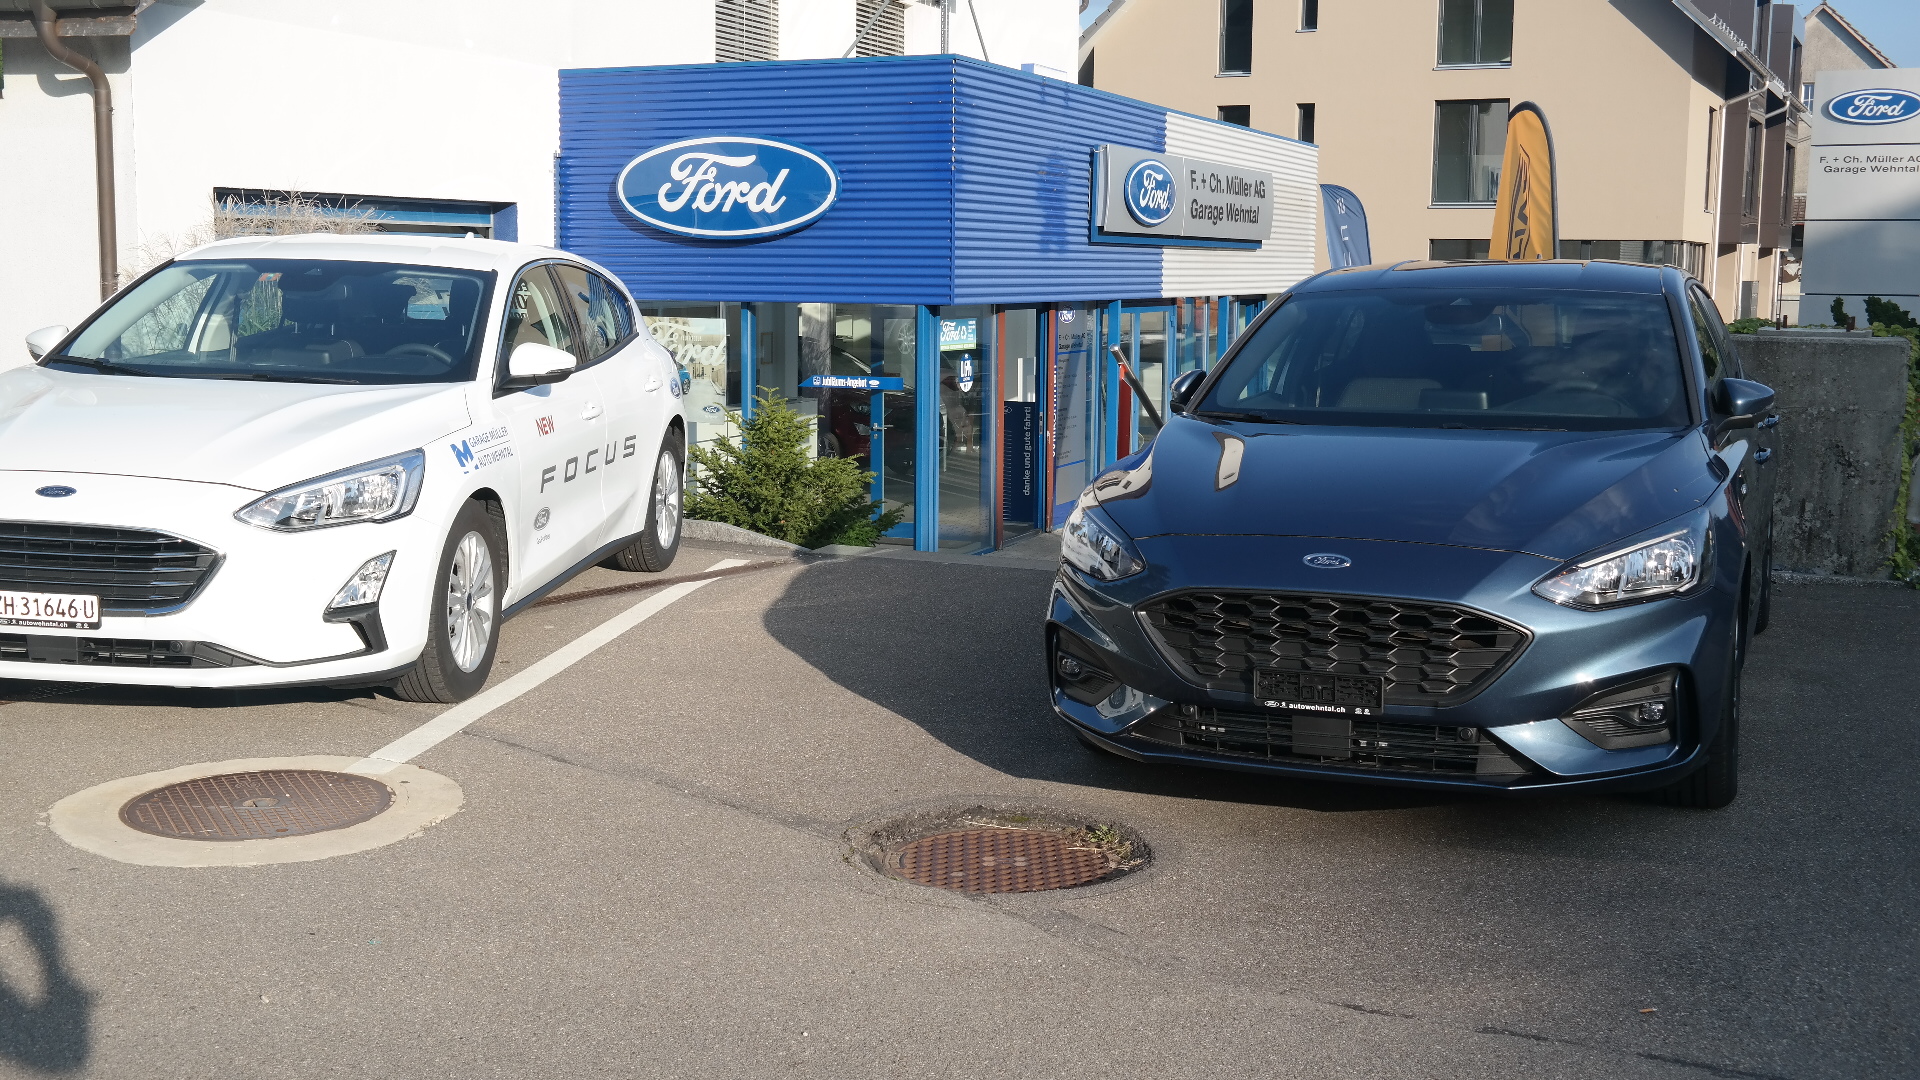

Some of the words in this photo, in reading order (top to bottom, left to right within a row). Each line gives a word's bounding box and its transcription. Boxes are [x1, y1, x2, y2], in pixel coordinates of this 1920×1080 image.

[1847, 95, 1907, 117] Ford
[1819, 156, 1829, 164] F.
[1843, 155, 1863, 164] Ch.
[1866, 155, 1904, 164] Müller
[1823, 165, 1867, 175] Garage
[1870, 164, 1920, 174] Wehntal
[657, 152, 790, 214] Ford
[1139, 169, 1171, 211] Ford
[1190, 169, 1199, 191] F.
[1201, 173, 1207, 189] +
[1209, 172, 1224, 194] Ch.
[1226, 174, 1253, 198] Müller
[1253, 179, 1266, 199] AG
[1190, 198, 1224, 226] Garage
[1226, 202, 1260, 224] Wehntal
[535, 415, 555, 437] NEW
[1023, 406, 1032, 431] fahrt!
[1024, 431, 1032, 452] gute
[540, 435, 637, 494] FOCUS
[1023, 452, 1031, 469] und
[1023, 469, 1031, 496] danke
[18, 620, 68, 628] autowehntal.ch
[1288, 702, 1346, 713] autowehntal.ch
